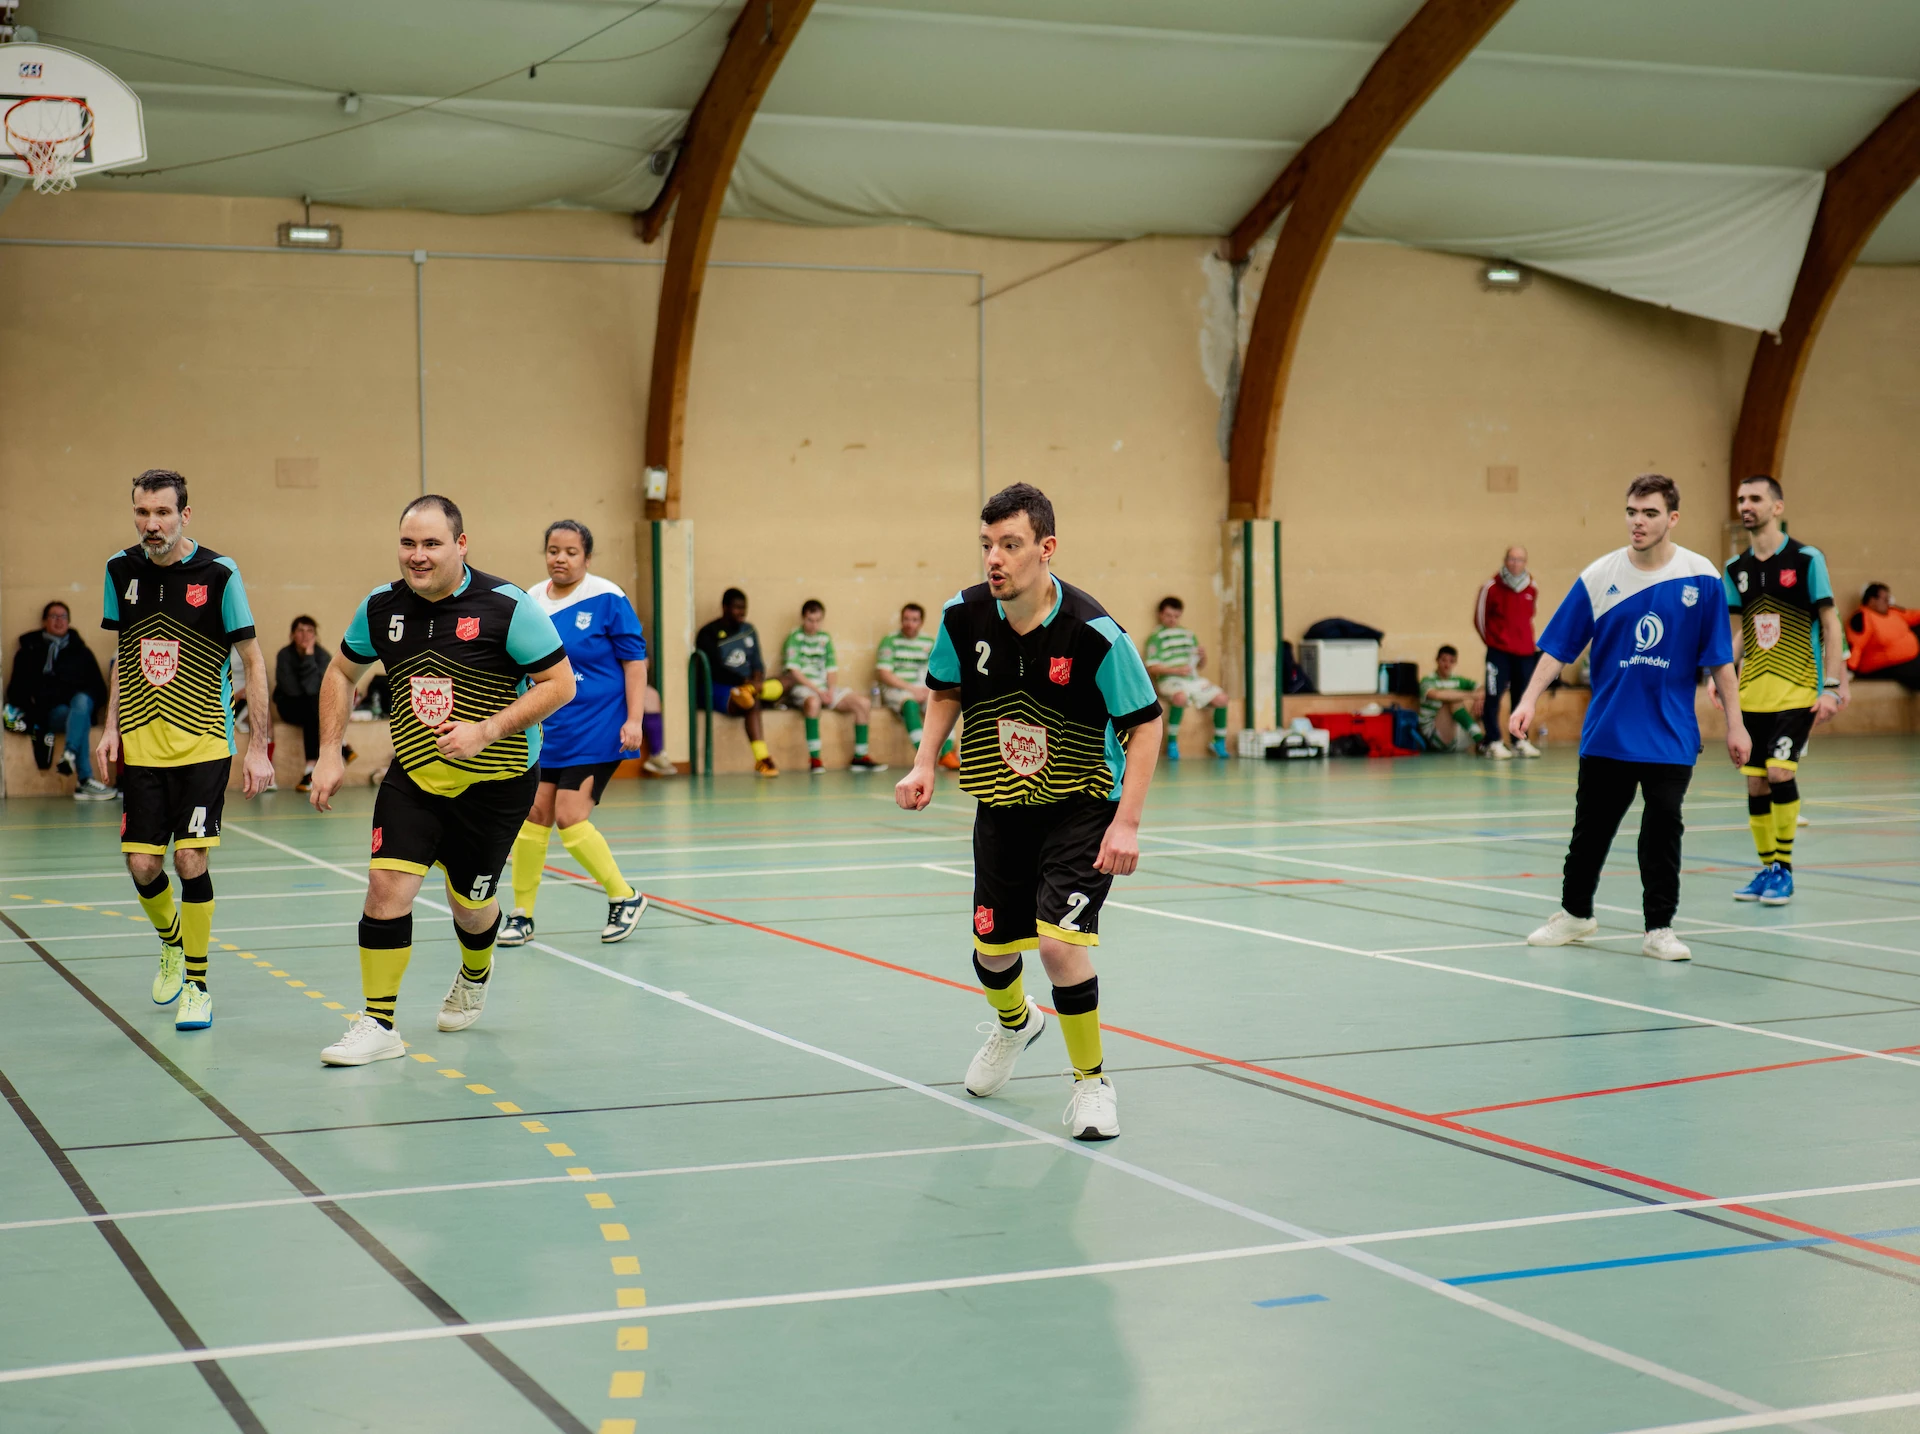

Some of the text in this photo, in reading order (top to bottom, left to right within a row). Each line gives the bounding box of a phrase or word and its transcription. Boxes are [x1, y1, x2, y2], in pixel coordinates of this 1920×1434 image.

[124, 579, 139, 605] 4
[1737, 570, 1749, 593] 3
[388, 614, 405, 642] 5
[975, 640, 991, 676] 2
[1014, 724, 1043, 734] AUVILLIERS
[1774, 736, 1793, 760] 3
[187, 806, 207, 838] 4
[469, 874, 493, 901] 5
[1058, 892, 1090, 930] 2
